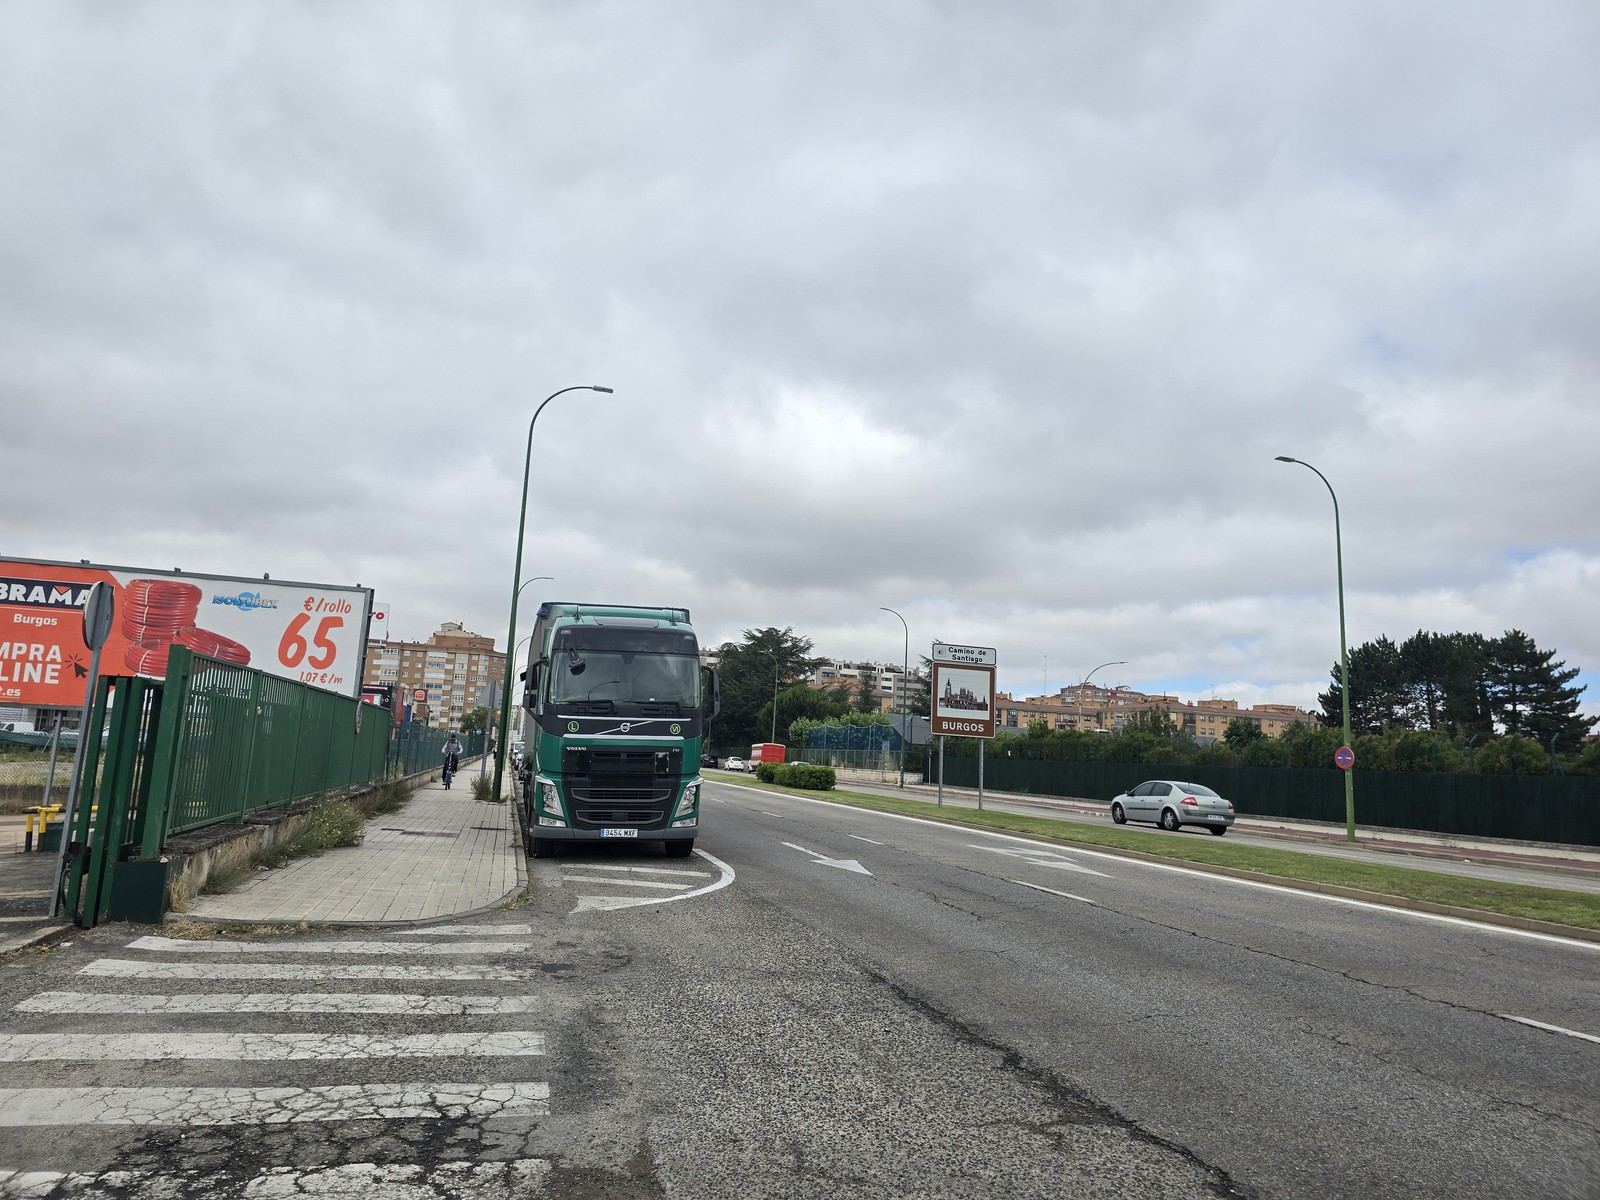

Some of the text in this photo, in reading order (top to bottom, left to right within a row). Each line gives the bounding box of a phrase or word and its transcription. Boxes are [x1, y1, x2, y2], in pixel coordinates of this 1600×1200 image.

[13, 613, 58, 626] Burgos
[278, 612, 344, 670] 65
[948, 647, 975, 655] Camino
[951, 654, 983, 663] Santiago
[942, 721, 985, 732] BURGOS
